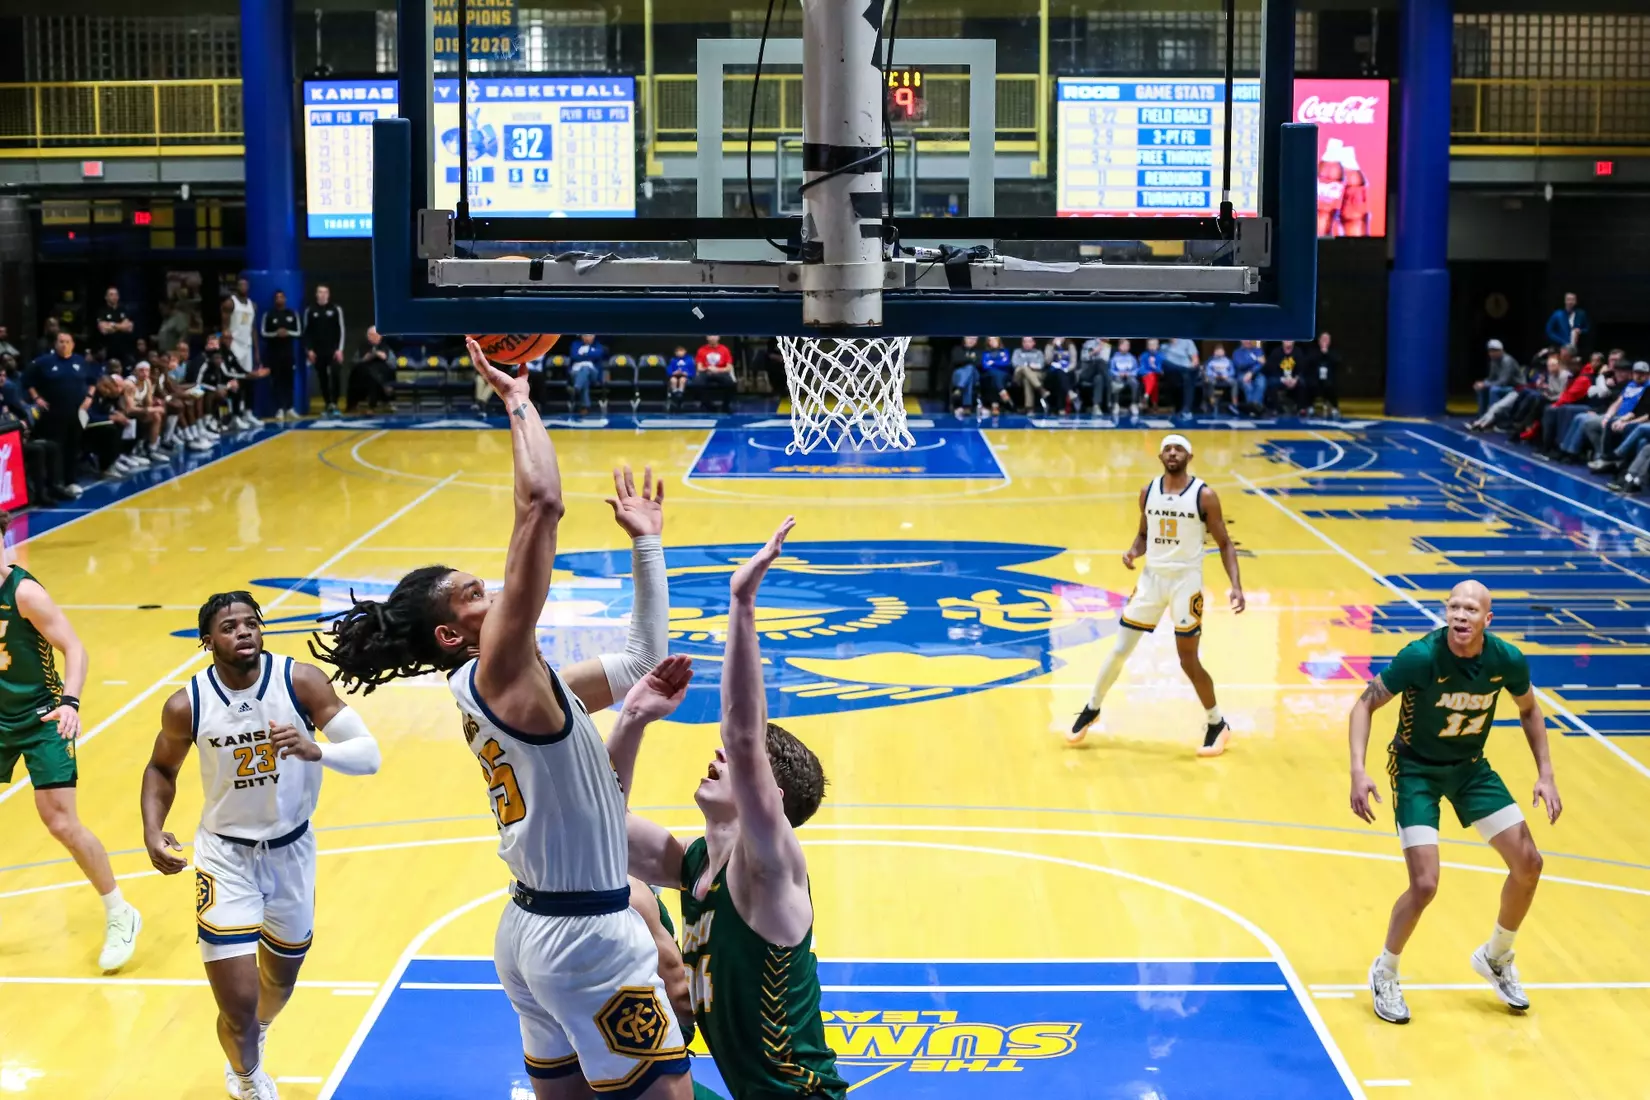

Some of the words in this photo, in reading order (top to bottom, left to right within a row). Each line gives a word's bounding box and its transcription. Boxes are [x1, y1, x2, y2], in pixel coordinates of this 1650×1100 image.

[311, 87, 394, 100] KANSAS
[485, 84, 626, 98] BASKETBALL
[1135, 85, 1173, 100] GAME
[1174, 85, 1215, 100] STATS
[895, 88, 914, 116] 9
[1142, 108, 1172, 123] FIELD
[512, 127, 543, 158] 32
[1153, 129, 1179, 144] 3-PT
[1181, 129, 1196, 144] FG
[1136, 150, 1164, 164] FREE
[1147, 509, 1195, 519] KANSAS
[1159, 518, 1177, 538] 13
[1154, 537, 1180, 545] CITY
[1435, 690, 1500, 711] NDSU
[208, 729, 272, 748] KANS
[233, 742, 277, 777] 23
[234, 773, 280, 789] CITY
[822, 1010, 958, 1025] LEA
[908, 1059, 1024, 1072] THE
